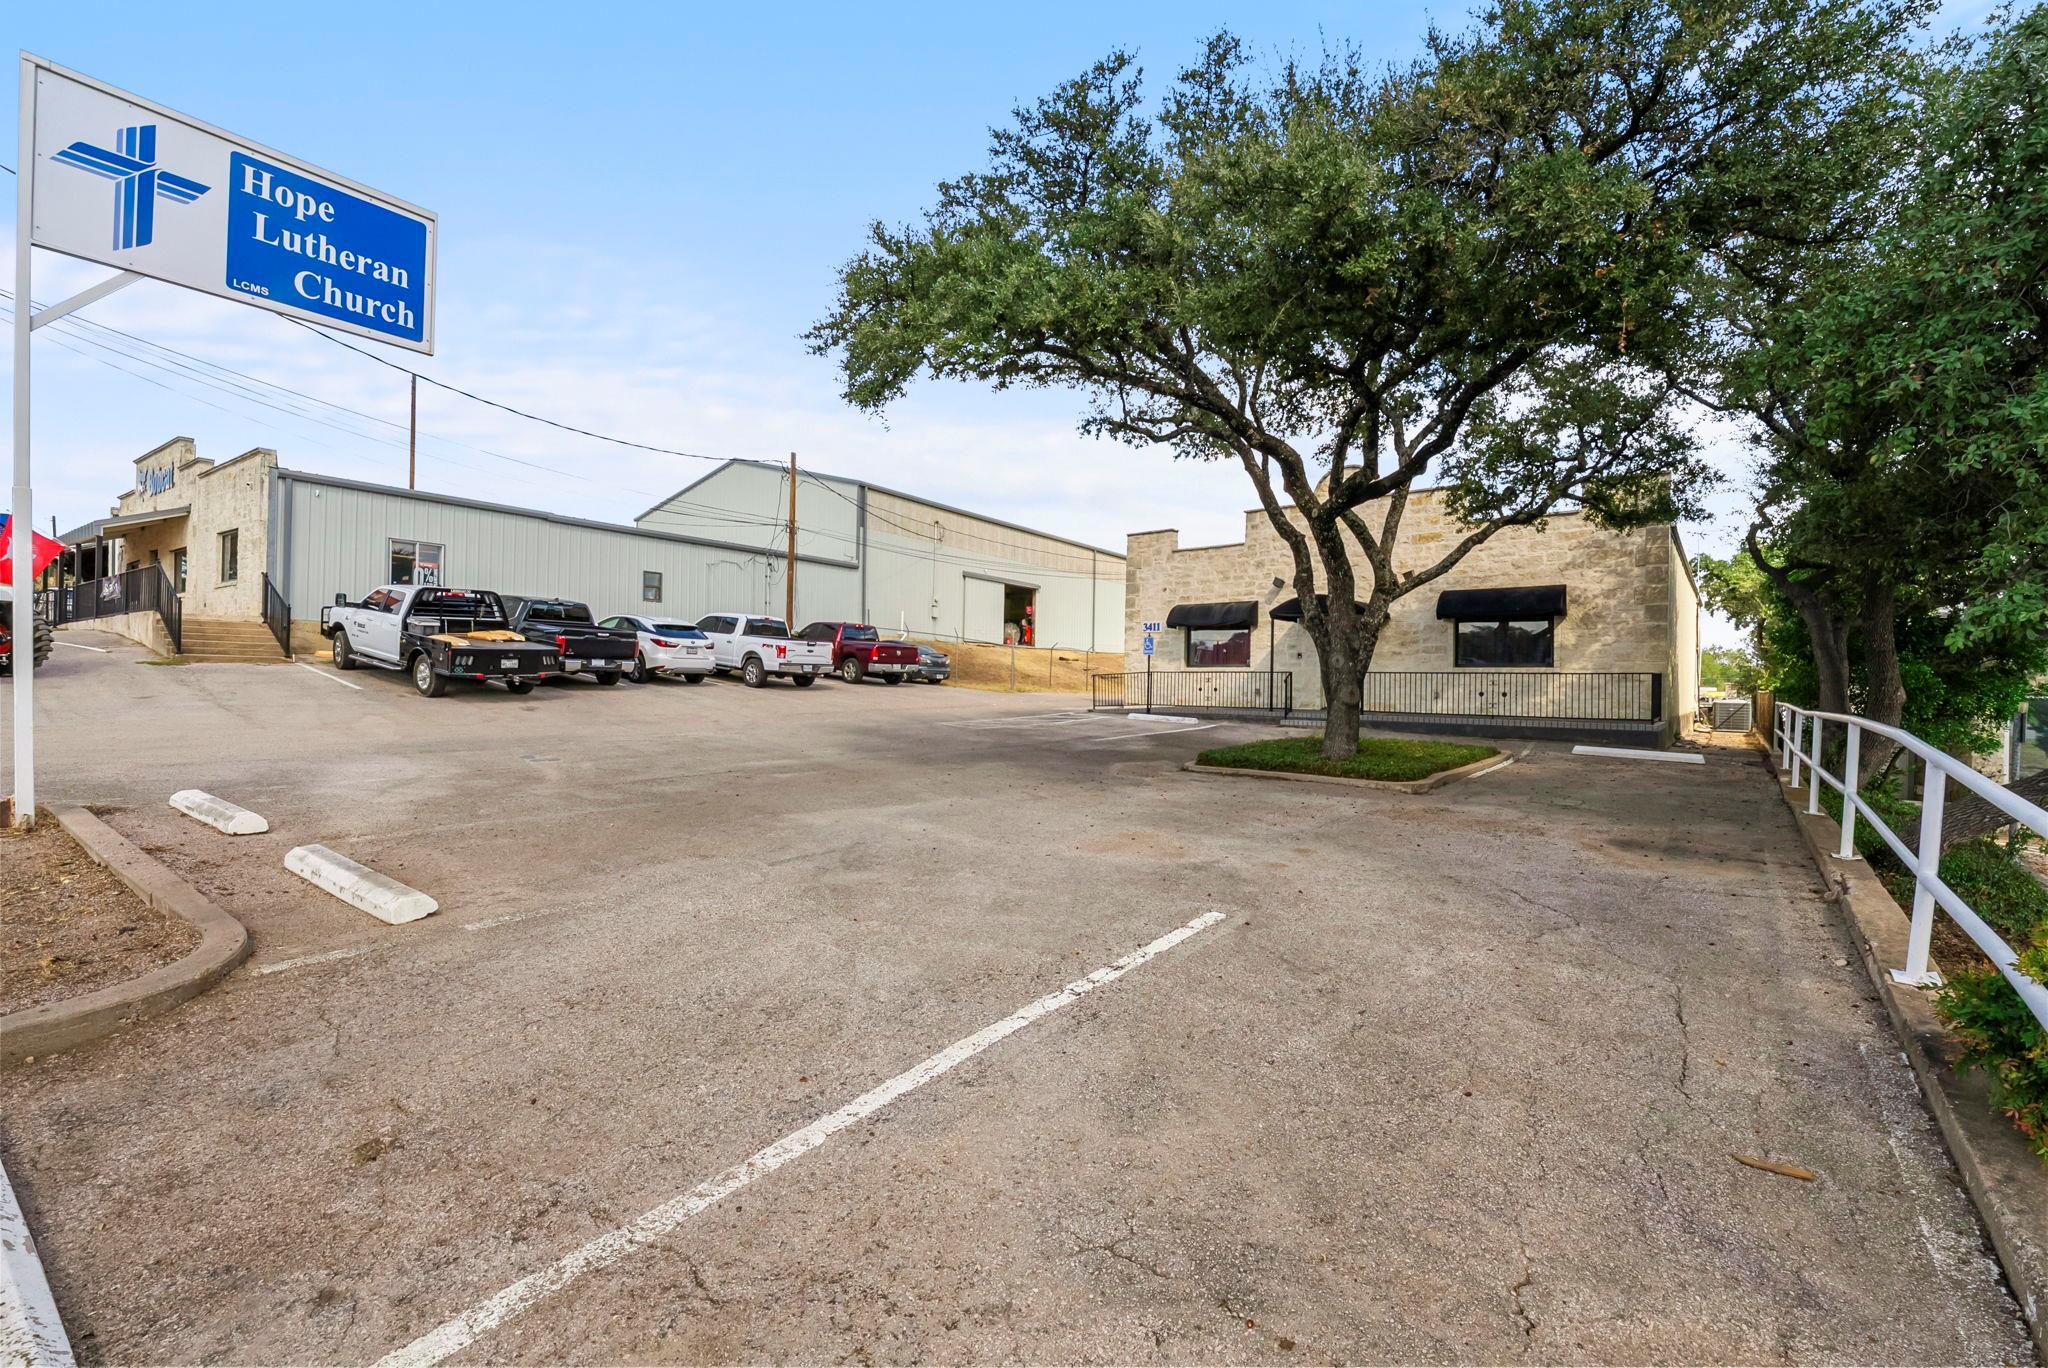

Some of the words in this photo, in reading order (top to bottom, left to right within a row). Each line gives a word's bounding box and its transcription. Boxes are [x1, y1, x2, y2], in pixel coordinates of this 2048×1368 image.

[241, 163, 335, 223] Hope
[252, 211, 409, 289] Lutheran
[233, 278, 270, 296] LCMS
[294, 270, 416, 330] Church
[1143, 622, 1160, 632] 3411
